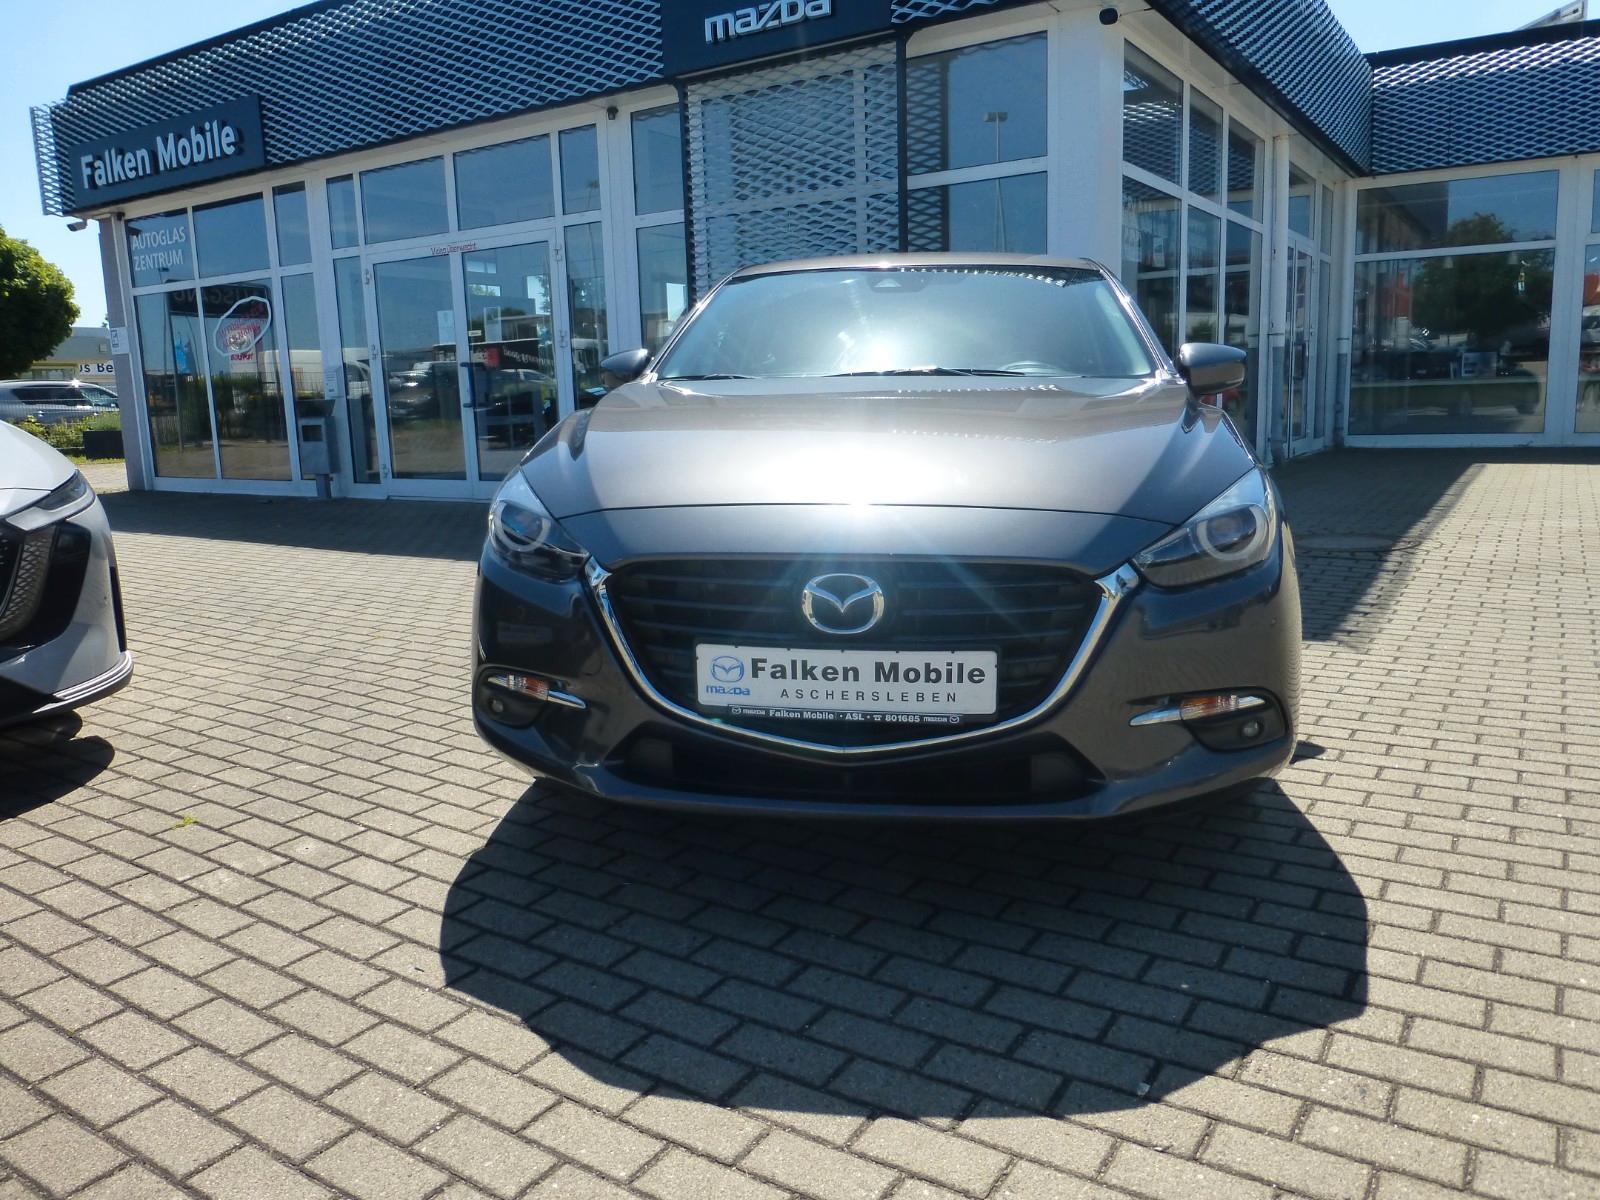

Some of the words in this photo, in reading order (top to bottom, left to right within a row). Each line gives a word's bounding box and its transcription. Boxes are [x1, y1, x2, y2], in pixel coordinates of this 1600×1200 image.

[80, 147, 151, 189] Falken
[156, 119, 236, 171] Mobile
[132, 226, 187, 250] AUTOGLAS
[133, 249, 184, 271] ZENTRUM
[751, 657, 860, 682] Falken
[874, 661, 986, 684] Mobile
[705, 684, 751, 696] mazda
[780, 688, 956, 703] ASCHERSLEBEN
[769, 709, 801, 719] Falken
[803, 711, 834, 720] Mobile
[845, 713, 865, 721] ASL
[885, 715, 920, 723] 801685
